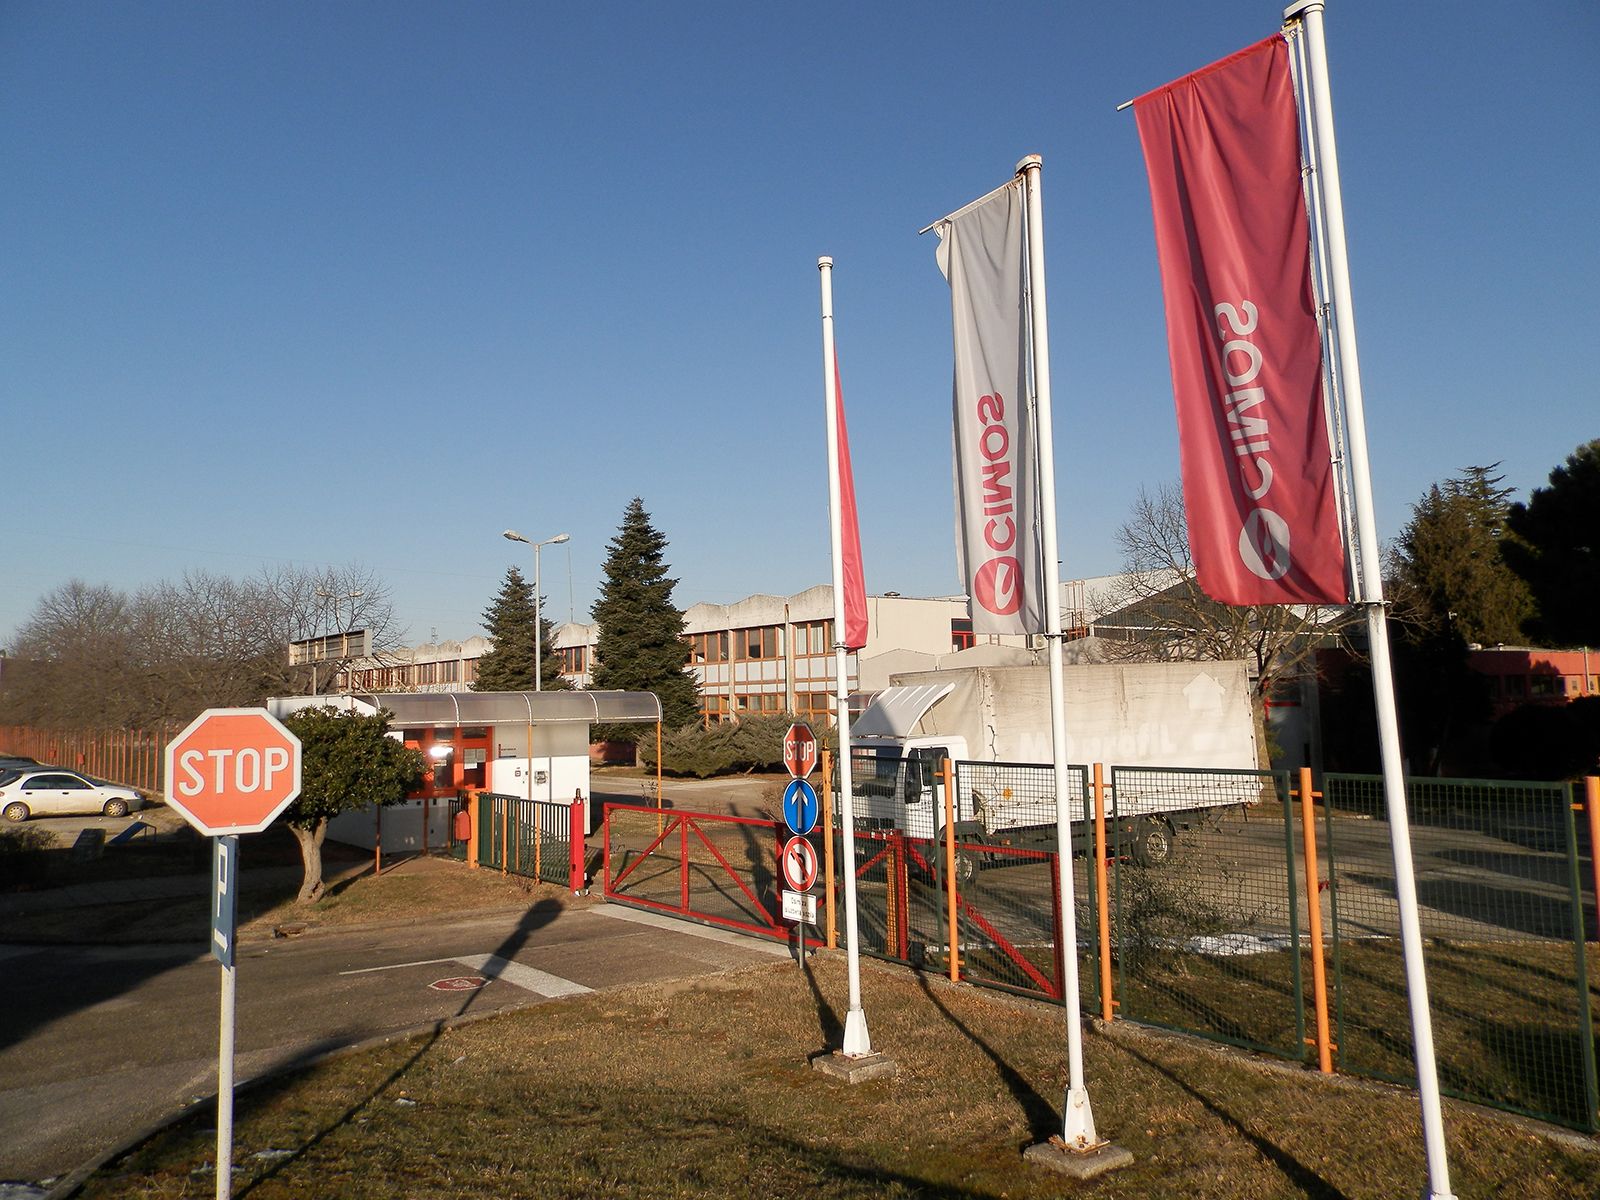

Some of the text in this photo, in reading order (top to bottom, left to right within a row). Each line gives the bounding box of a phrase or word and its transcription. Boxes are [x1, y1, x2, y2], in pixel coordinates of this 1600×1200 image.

[179, 747, 289, 796] STOP
[786, 741, 813, 761] STOP
[217, 843, 228, 917] P
